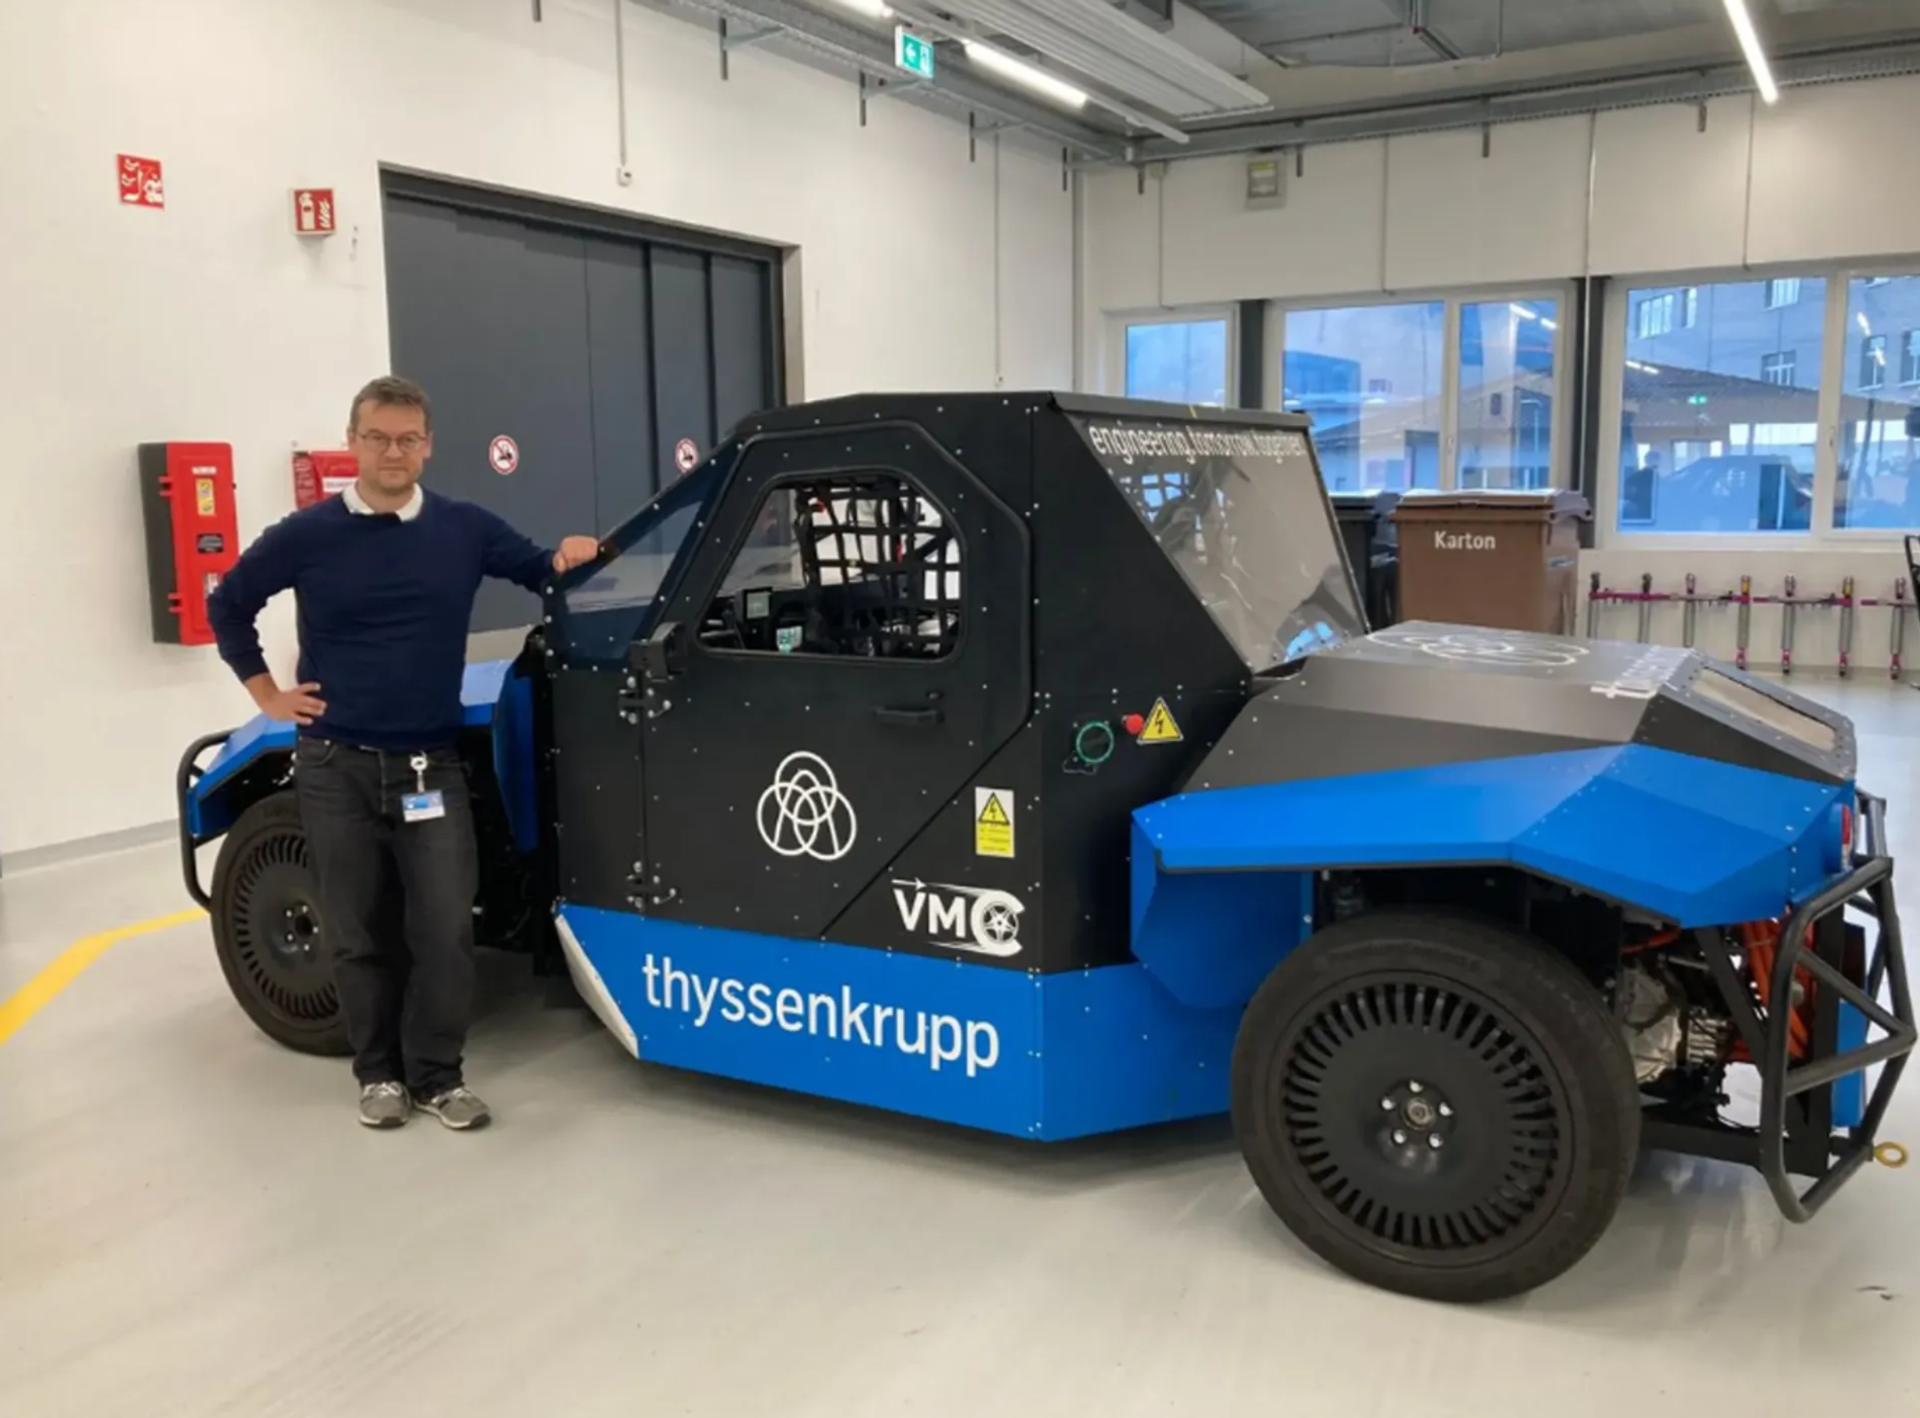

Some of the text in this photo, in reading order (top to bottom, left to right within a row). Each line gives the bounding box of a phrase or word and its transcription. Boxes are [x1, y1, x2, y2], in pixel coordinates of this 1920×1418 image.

[1434, 530, 1496, 549] Karton
[893, 888, 1025, 957] VMC
[642, 953, 1000, 1077] thyssenkrupp
